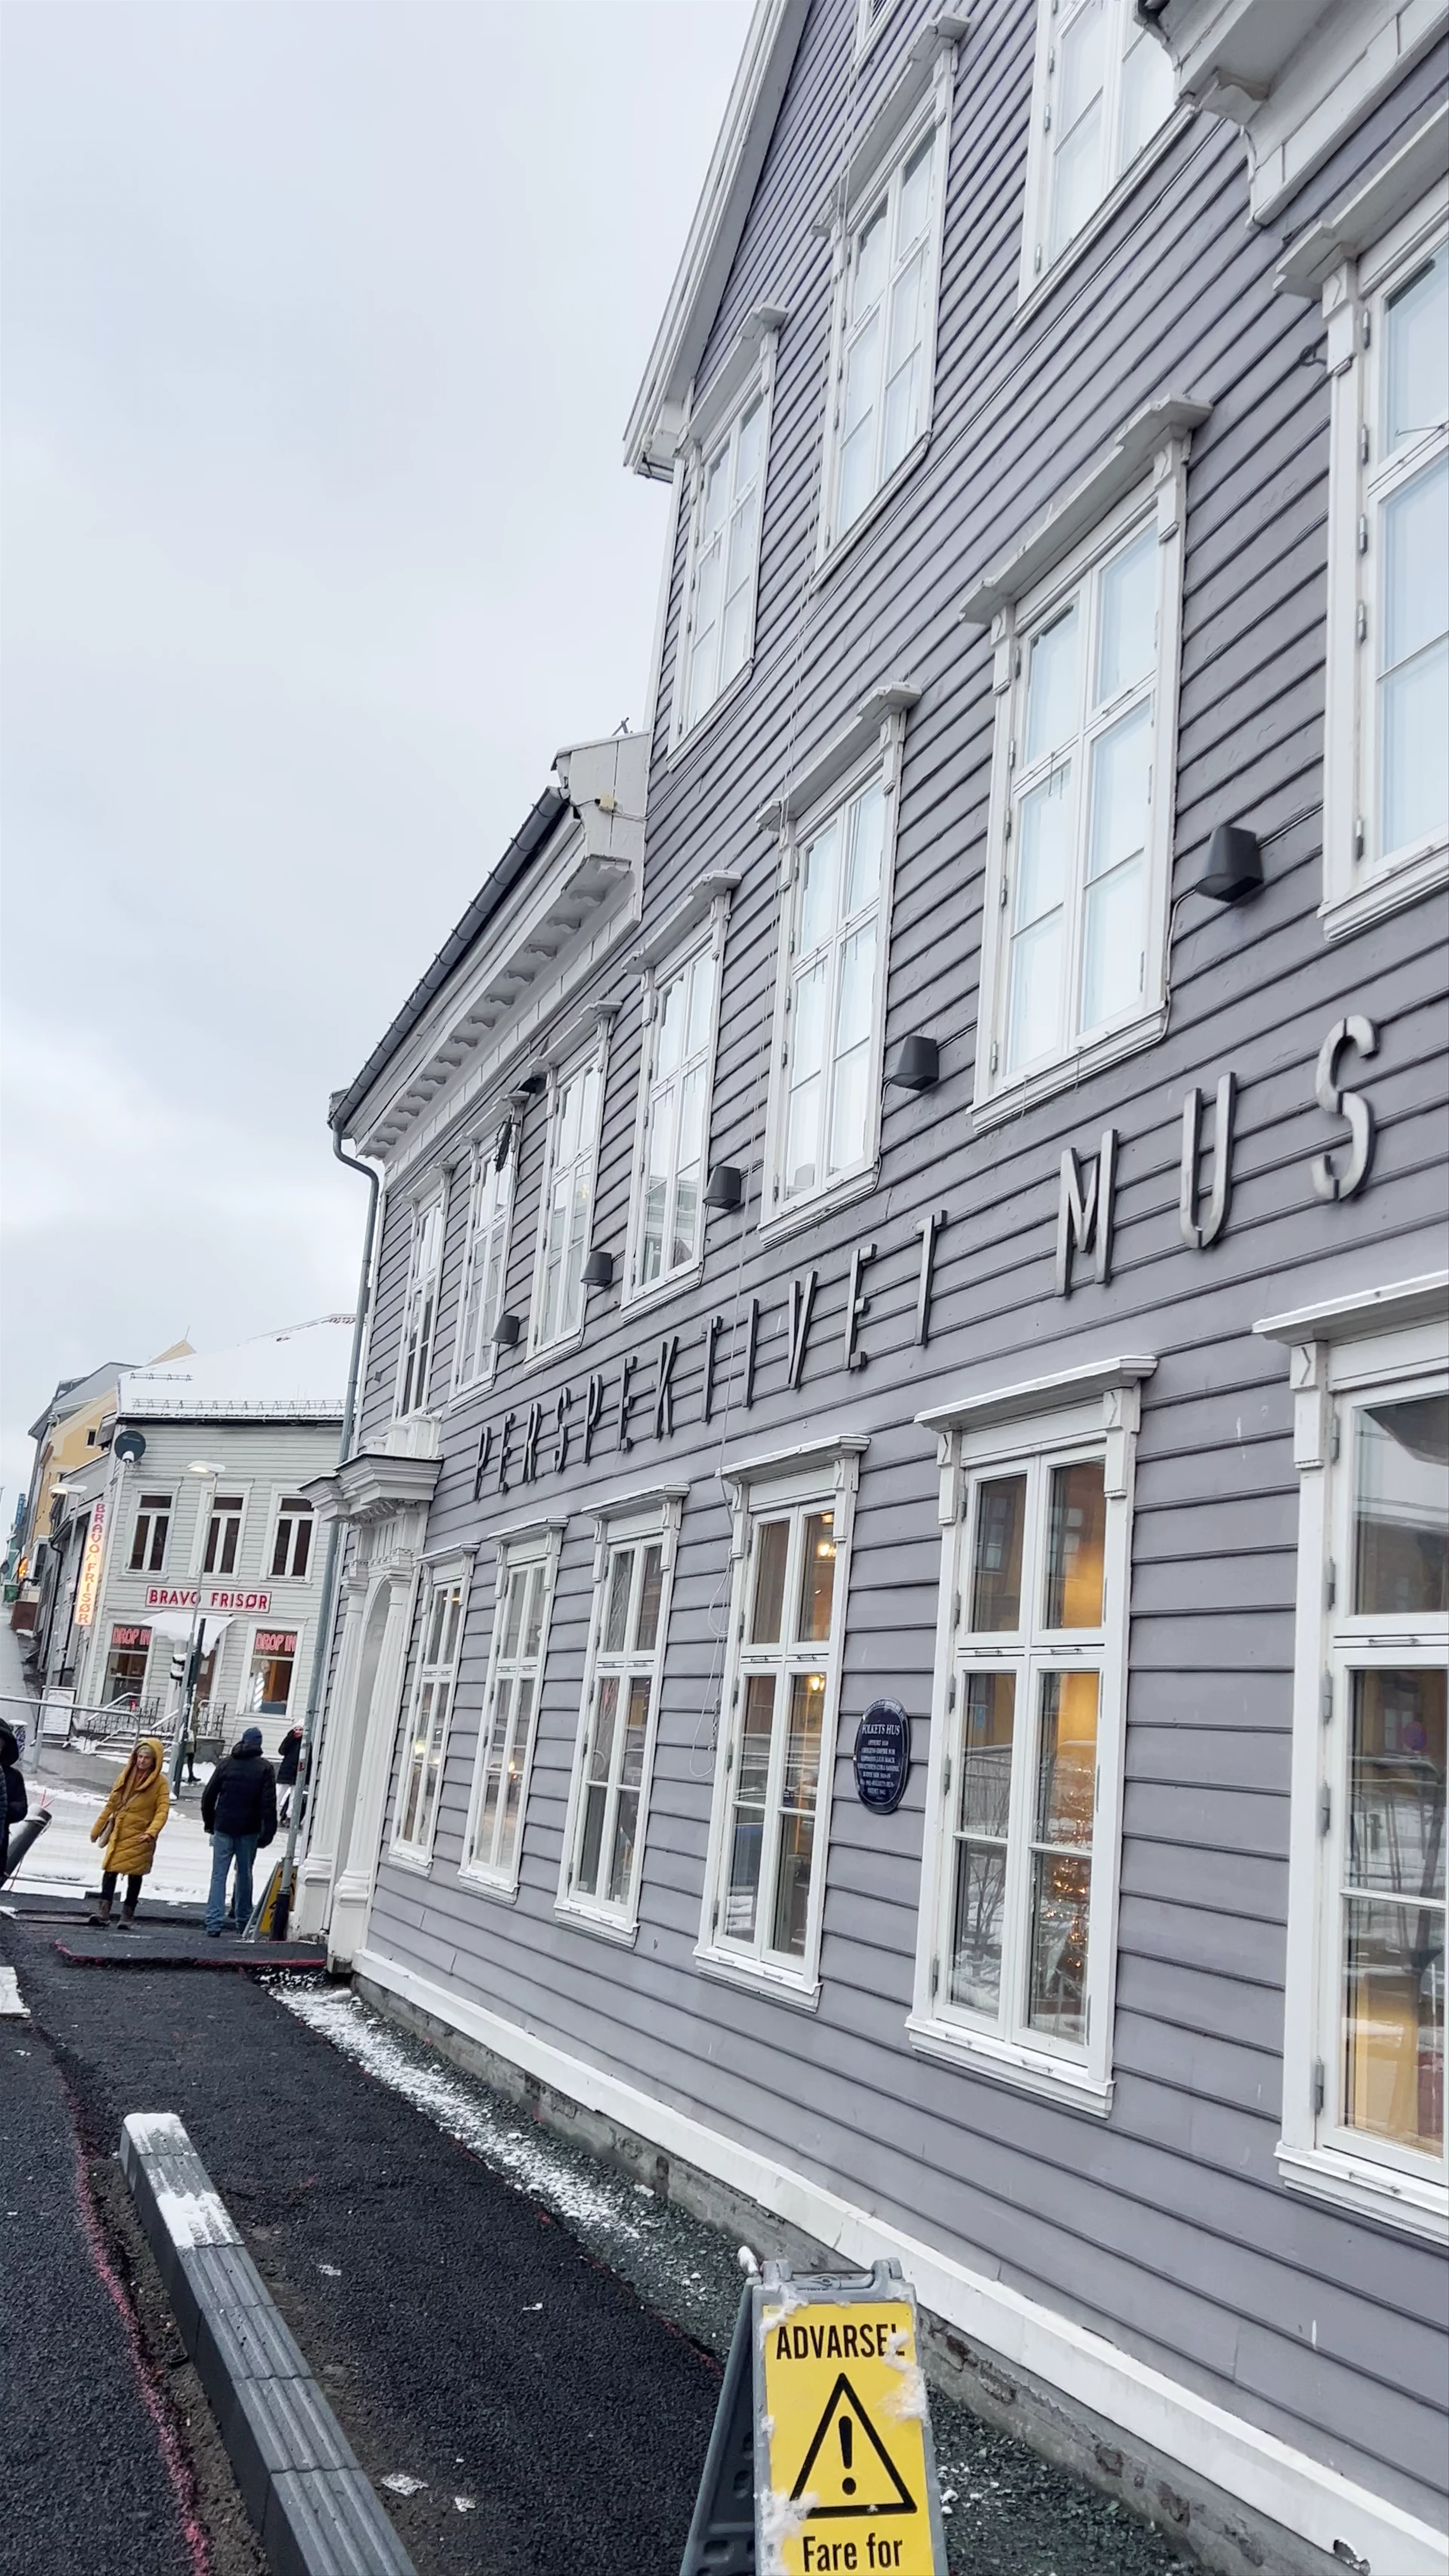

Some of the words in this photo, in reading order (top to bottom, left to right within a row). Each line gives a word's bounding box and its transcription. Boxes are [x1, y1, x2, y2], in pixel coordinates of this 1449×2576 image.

[474, 1210, 947, 1501] PERSPEKTIVET
[89, 1503, 105, 1553] BRAVO
[78, 1563, 97, 1623] FRISØR
[149, 1589, 201, 1606] BRAVO
[211, 1592, 268, 1609] FRISØR
[113, 1627, 140, 1644] DROP
[139, 1629, 151, 1646] IN
[255, 1633, 285, 1651] DROP
[284, 1635, 297, 1652] IN
[861, 1724, 886, 1735] FOLKETS
[886, 1724, 900, 1736] HUS
[803, 2535, 858, 2573] Fare
[866, 2532, 903, 2568] for
